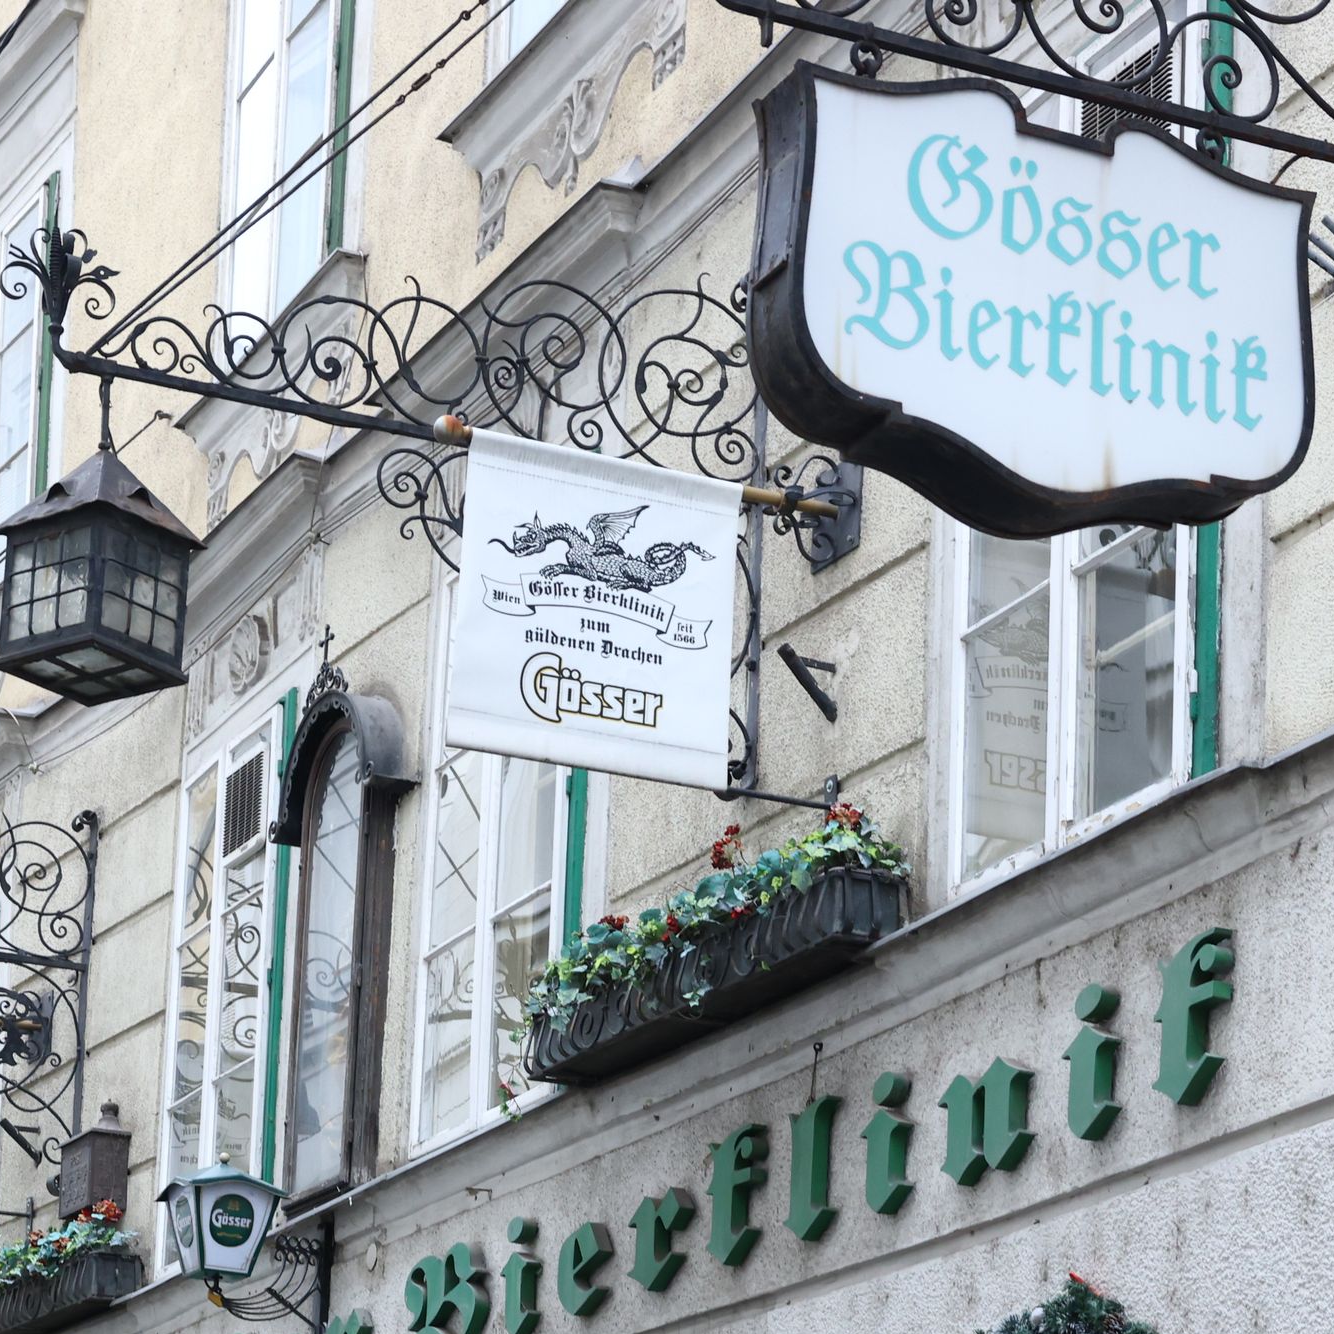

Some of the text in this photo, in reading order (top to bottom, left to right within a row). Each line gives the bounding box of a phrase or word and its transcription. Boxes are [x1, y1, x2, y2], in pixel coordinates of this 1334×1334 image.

[908, 133, 1221, 299] Gösser
[842, 241, 1268, 431] Bierklinik
[492, 589, 520, 605] Wien
[583, 585, 665, 622] Bierklinik
[580, 618, 610, 633] zum
[673, 634, 696, 645] 1566
[525, 627, 663, 665] güldenen Drachen
[520, 652, 663, 728] Gösser
[212, 1208, 252, 1228] Gösser
